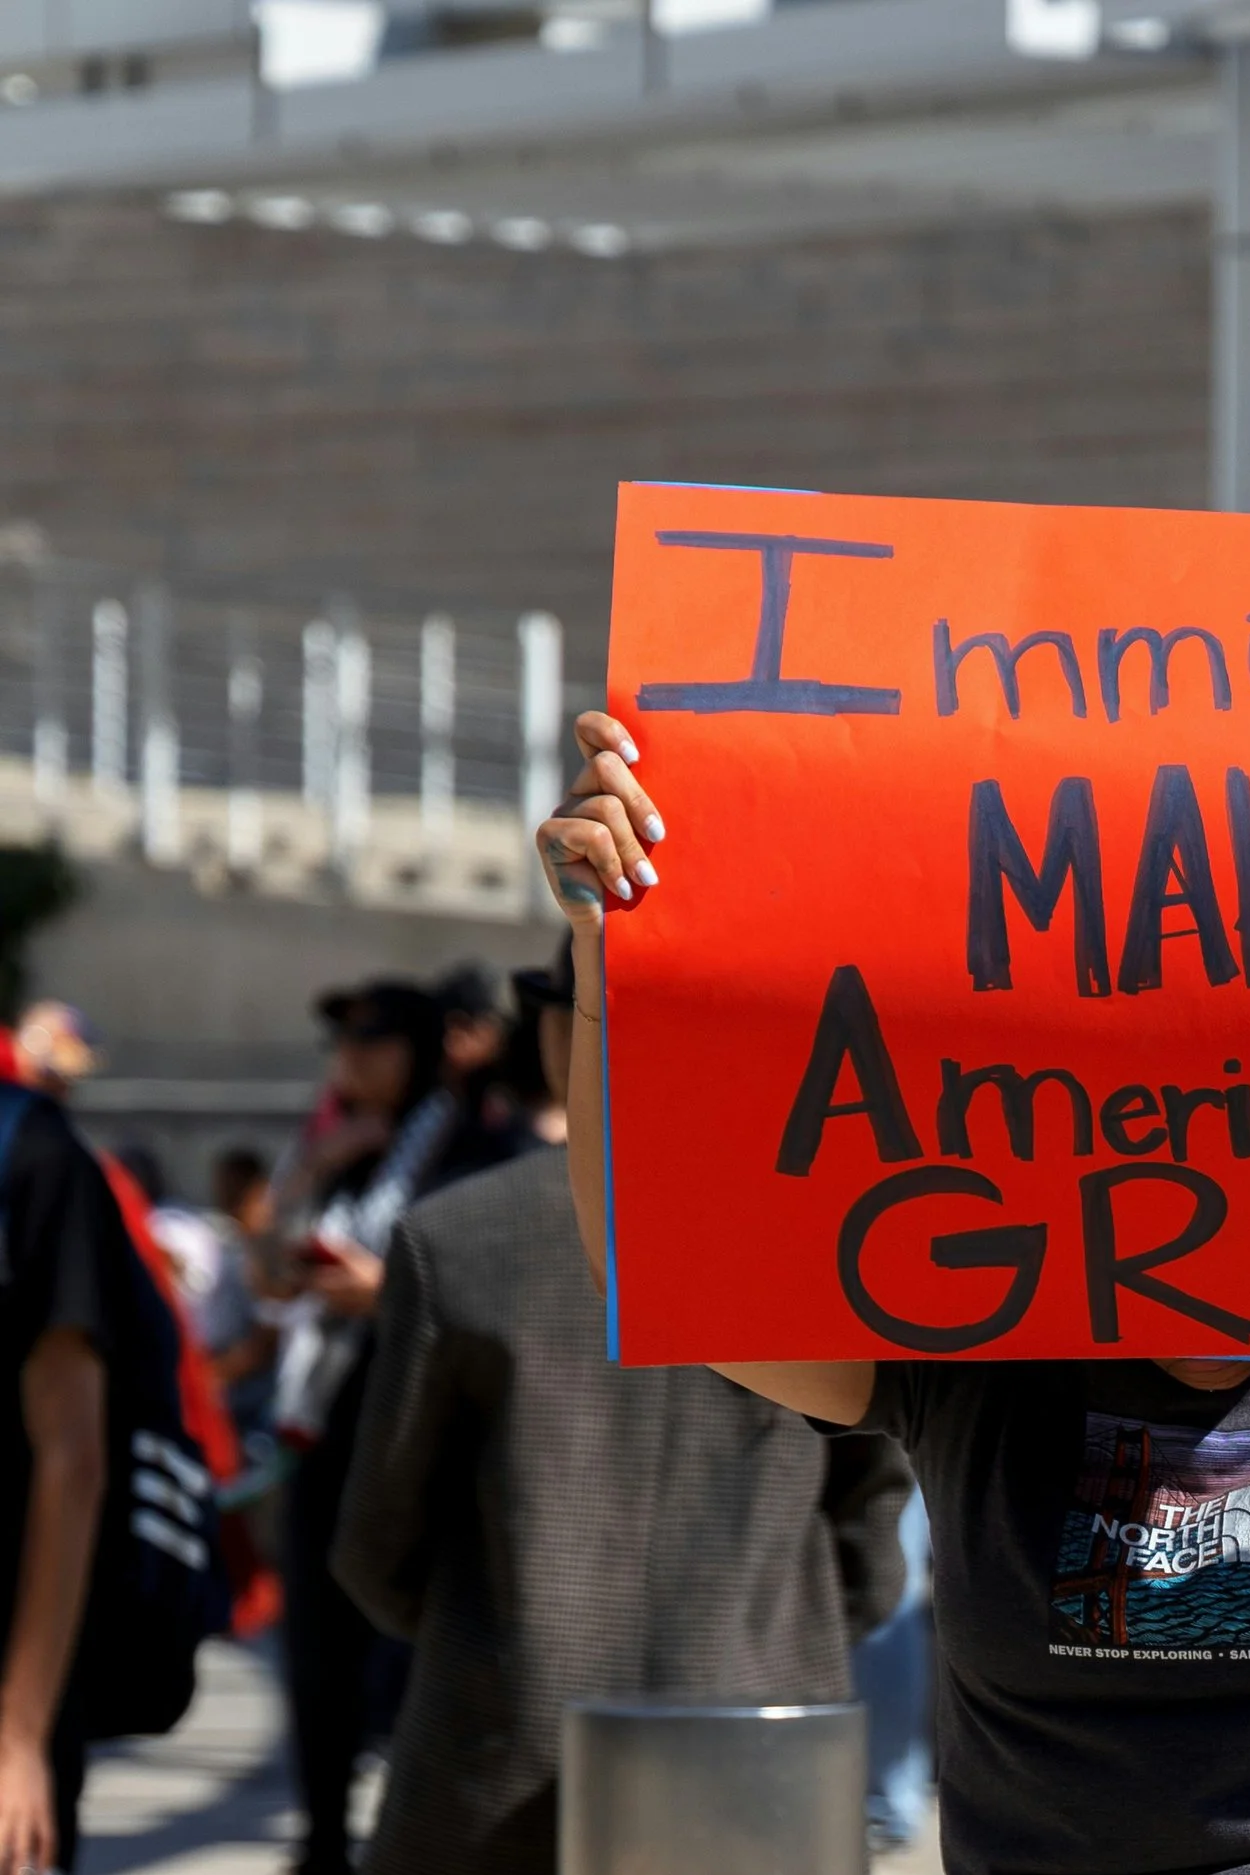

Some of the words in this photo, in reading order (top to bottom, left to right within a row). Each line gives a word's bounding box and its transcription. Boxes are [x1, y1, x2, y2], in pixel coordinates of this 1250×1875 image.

[1159, 1495, 1226, 1530] THE
[1091, 1513, 1221, 1552] NORTH
[1125, 1539, 1220, 1575] FACE
[1048, 1644, 1093, 1658] NEVER
[1095, 1647, 1130, 1660] STOP
[1133, 1649, 1213, 1661] EXPLORING
